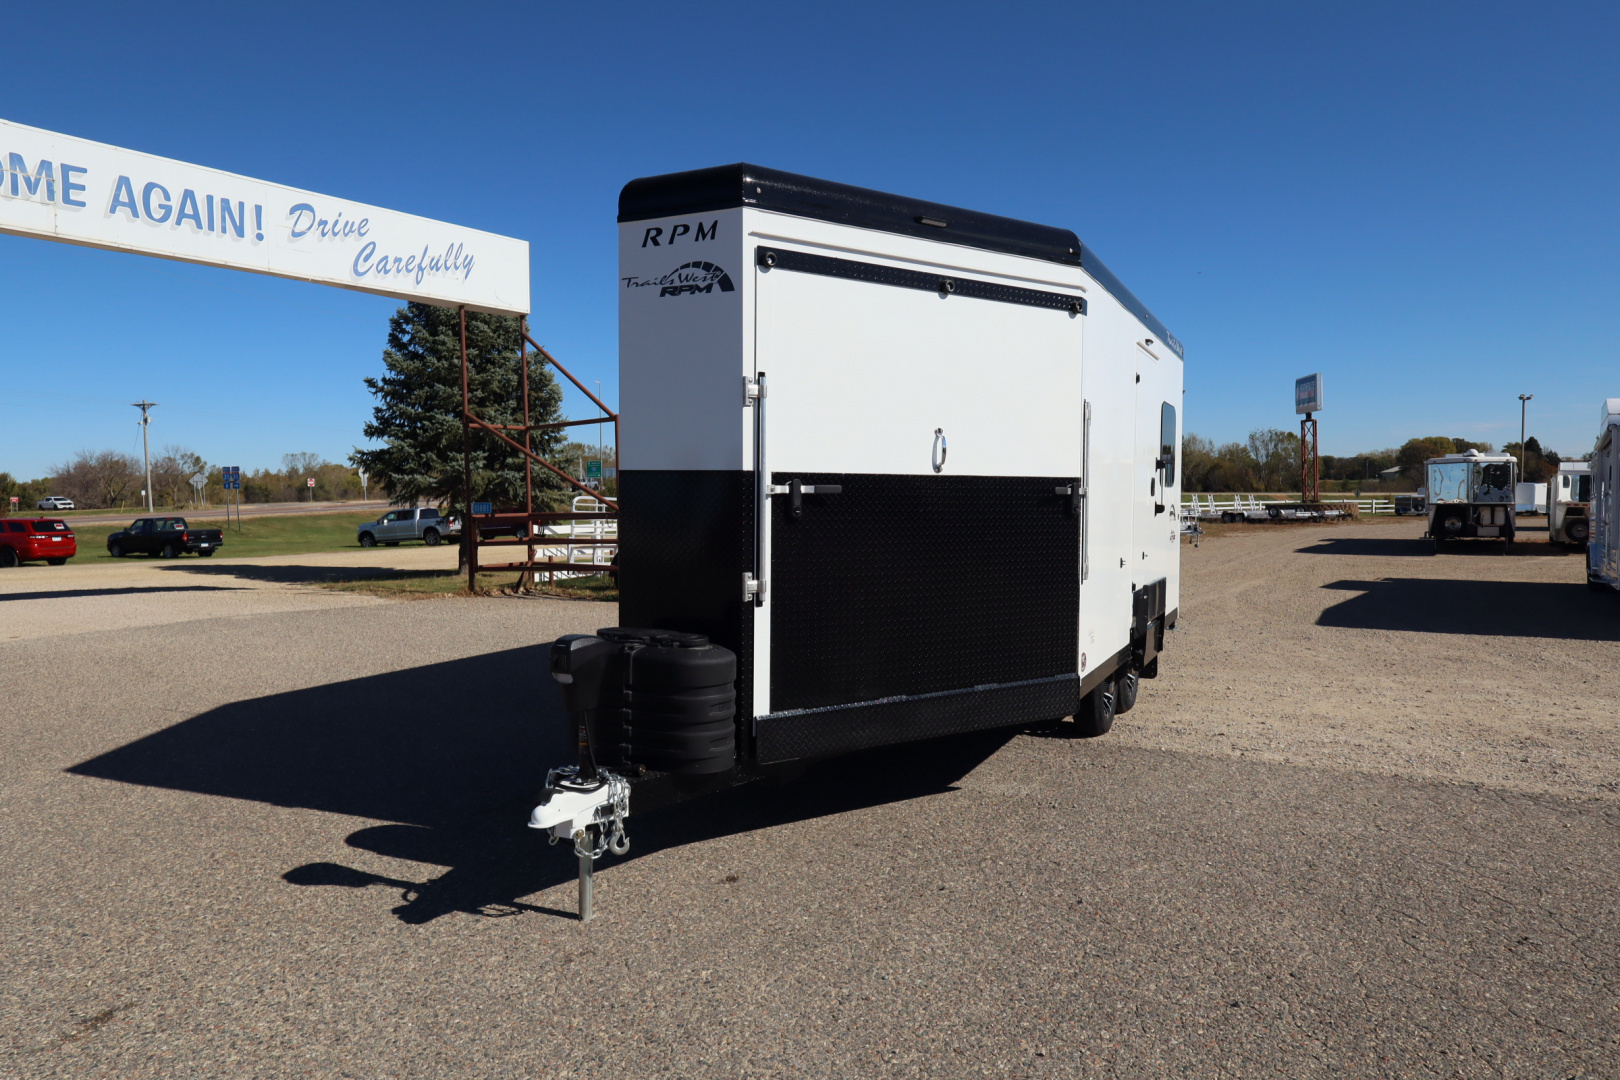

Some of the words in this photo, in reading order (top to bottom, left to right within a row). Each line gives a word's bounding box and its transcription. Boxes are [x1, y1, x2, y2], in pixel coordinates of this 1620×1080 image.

[0, 152, 87, 208] ME
[109, 175, 265, 241] AGAIN!
[288, 203, 371, 239] Drive
[642, 220, 718, 248] RPM
[352, 241, 475, 285] Carefully
[621, 275, 678, 288] Trails
[678, 272, 717, 283] West
[659, 282, 714, 297] RPM
